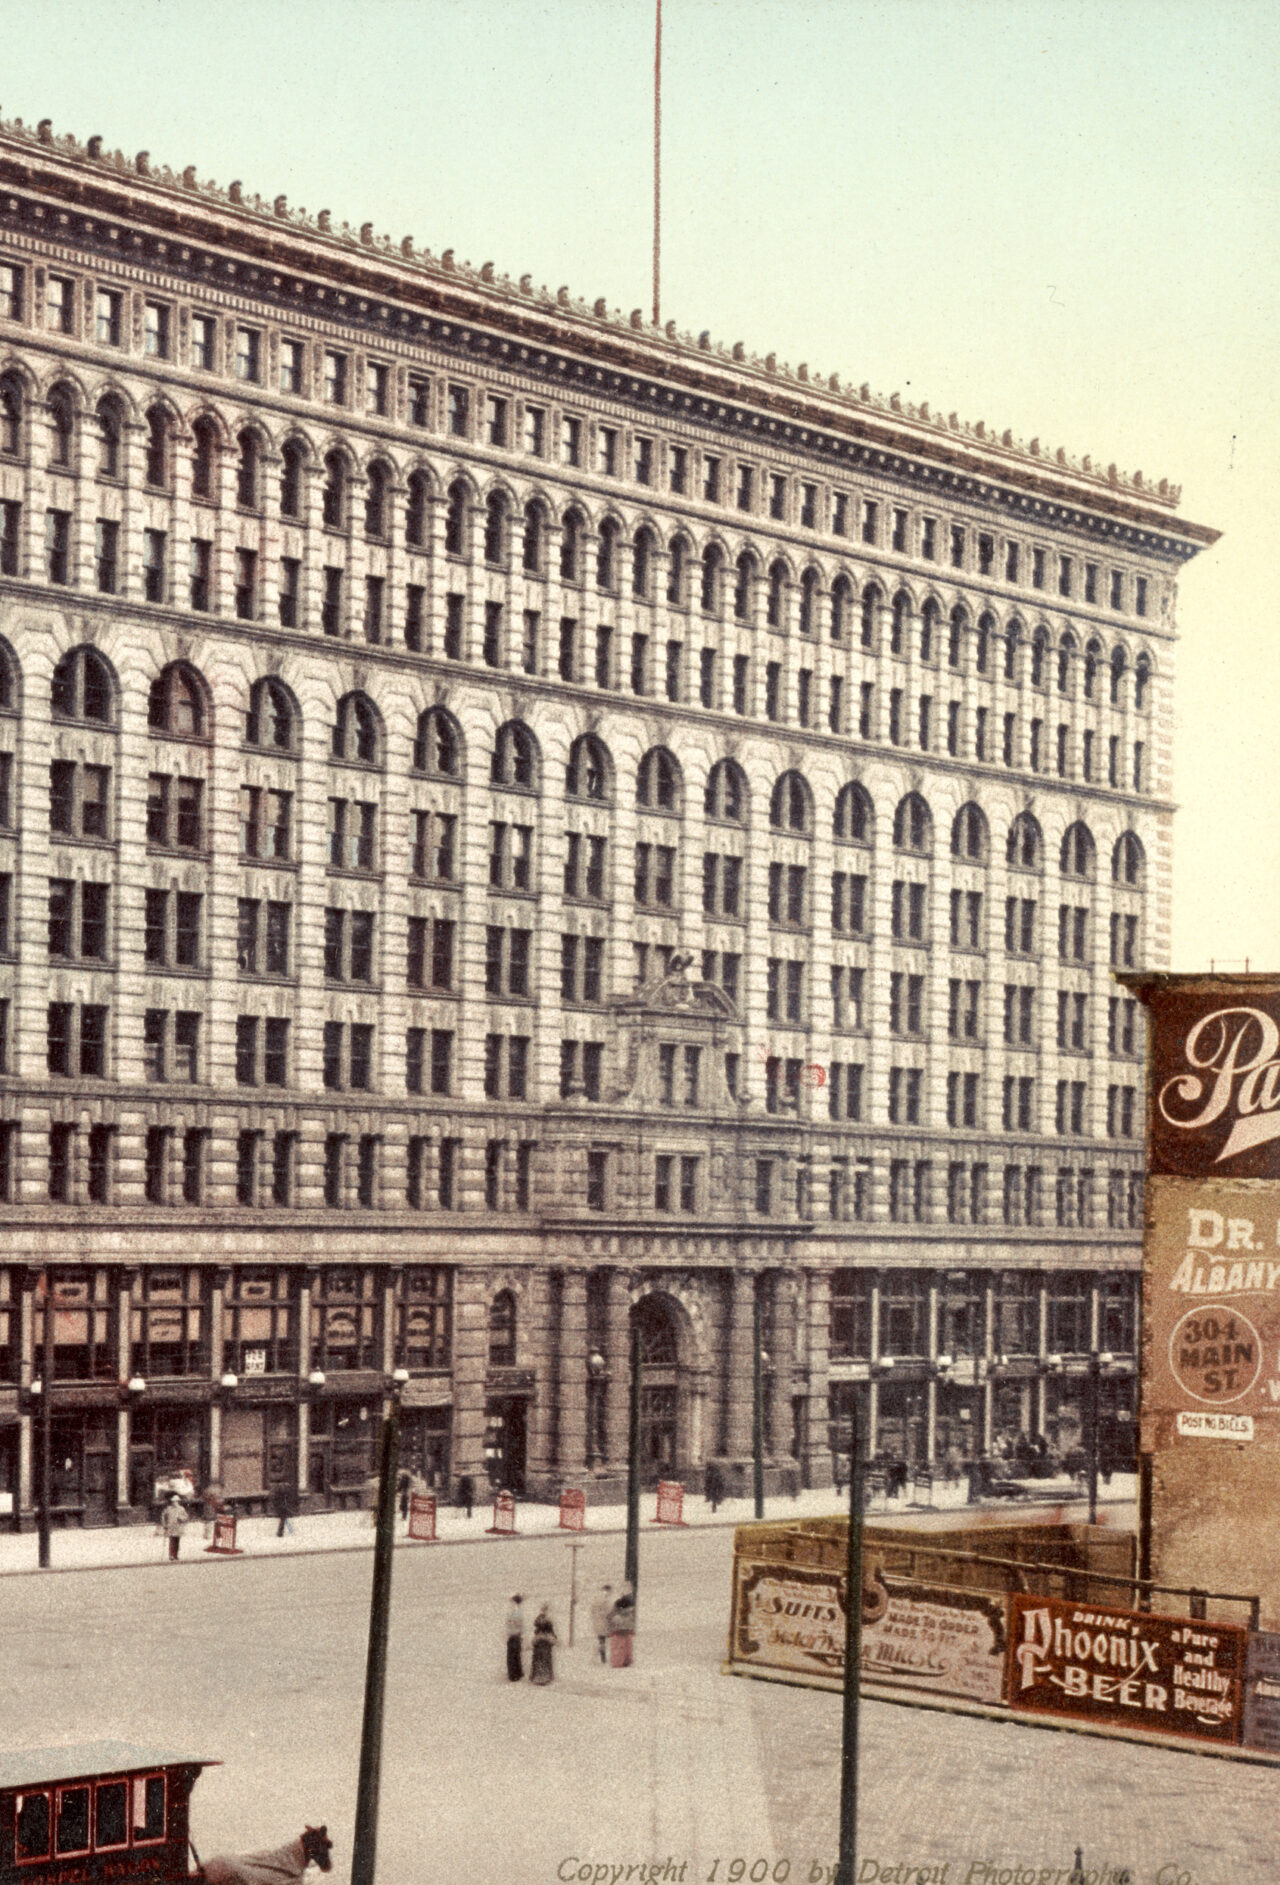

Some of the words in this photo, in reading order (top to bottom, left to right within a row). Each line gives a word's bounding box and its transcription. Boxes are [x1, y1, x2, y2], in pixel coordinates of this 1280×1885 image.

[1169, 1252, 1280, 1294] ALBANY
[1179, 1343, 1254, 1368] MAIN
[1016, 1607, 1160, 1690] Phoenix
[1183, 1650, 1215, 1668] and
[1064, 1666, 1168, 1712] BEER
[1173, 1664, 1232, 1701] Healthy
